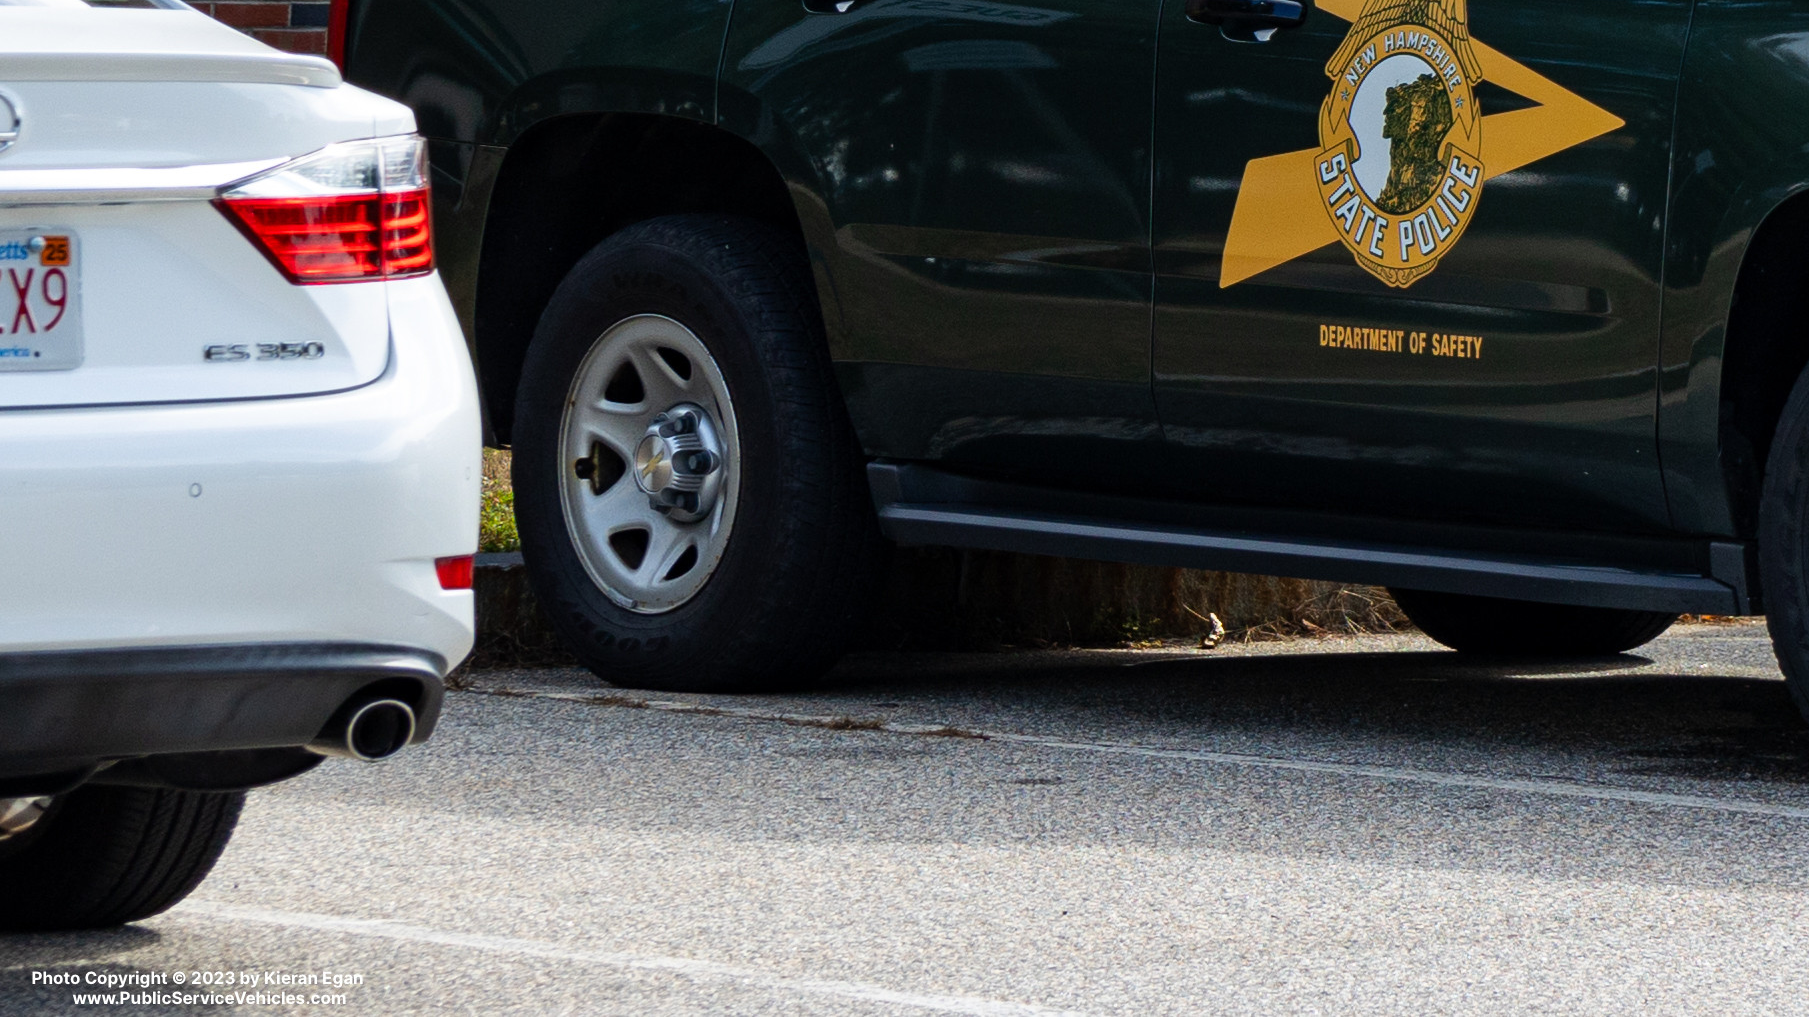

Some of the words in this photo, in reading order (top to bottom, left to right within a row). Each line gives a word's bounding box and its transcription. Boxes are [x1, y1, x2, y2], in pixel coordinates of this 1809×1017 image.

[1345, 43, 1377, 87] NEW
[1384, 31, 1462, 92] HAMPSHIRE
[1319, 152, 1388, 259] STATE
[1398, 155, 1481, 262] POLICE
[46, 243, 69, 261] 25
[0, 268, 67, 334] X9
[203, 343, 251, 362] ES
[255, 341, 325, 361] 350
[1319, 324, 1404, 353] DEPARTMENT
[1409, 331, 1427, 355] OF
[1432, 333, 1483, 359] SAFETY
